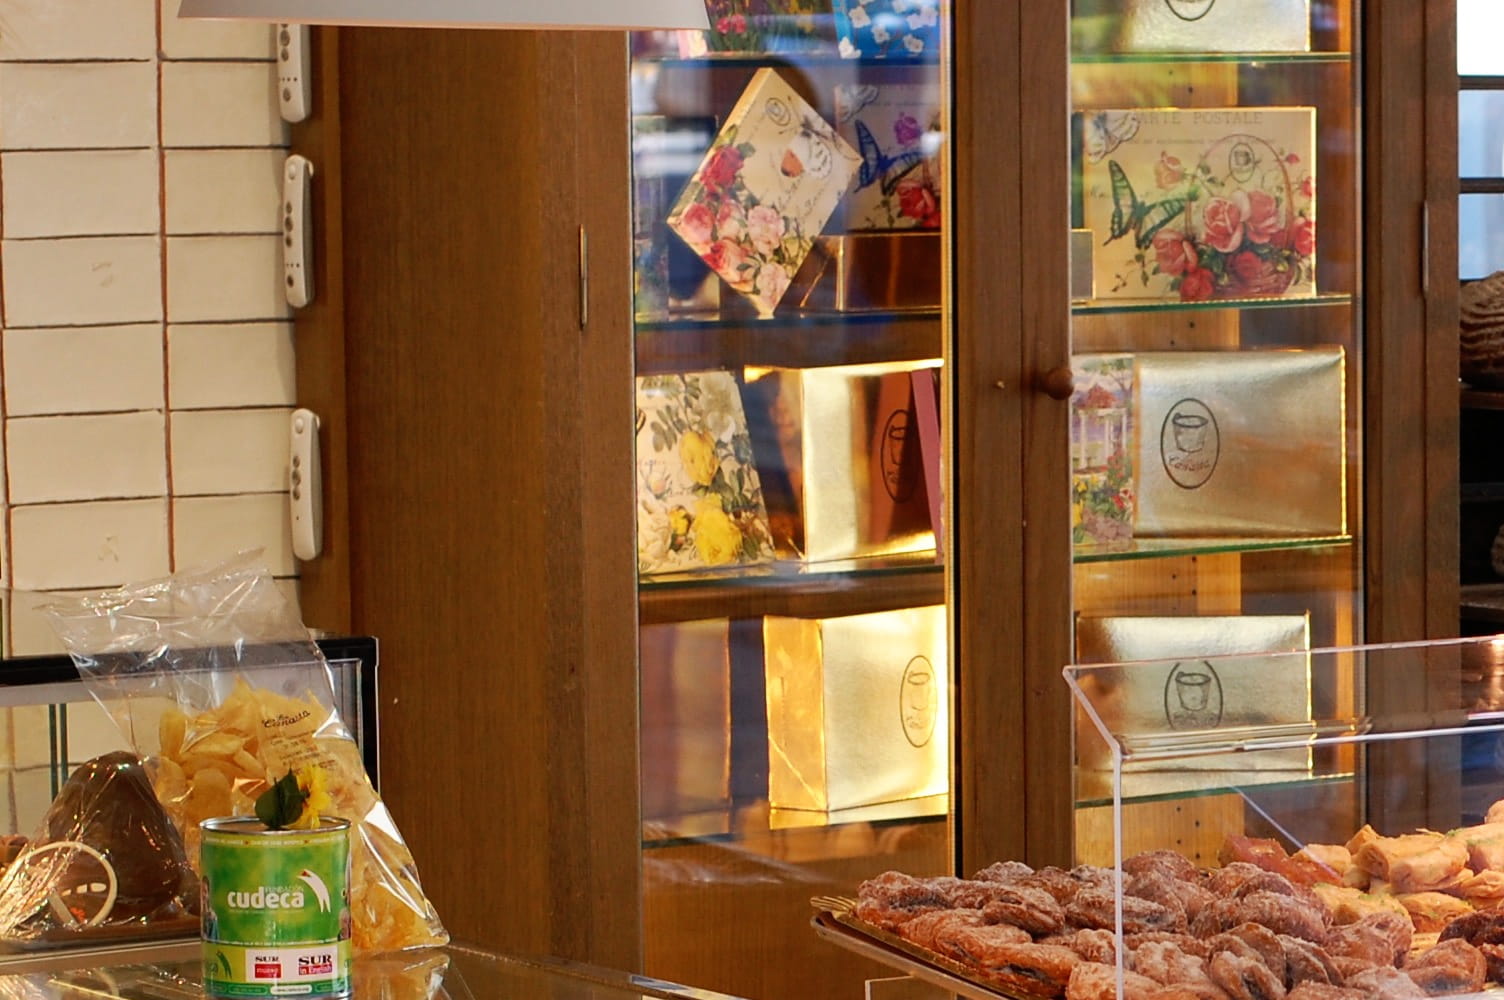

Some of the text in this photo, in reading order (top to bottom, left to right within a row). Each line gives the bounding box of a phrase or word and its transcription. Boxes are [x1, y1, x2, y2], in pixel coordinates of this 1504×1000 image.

[1193, 111, 1263, 125] POSTALE
[227, 886, 304, 908] cudeca
[298, 954, 332, 965] SUR
